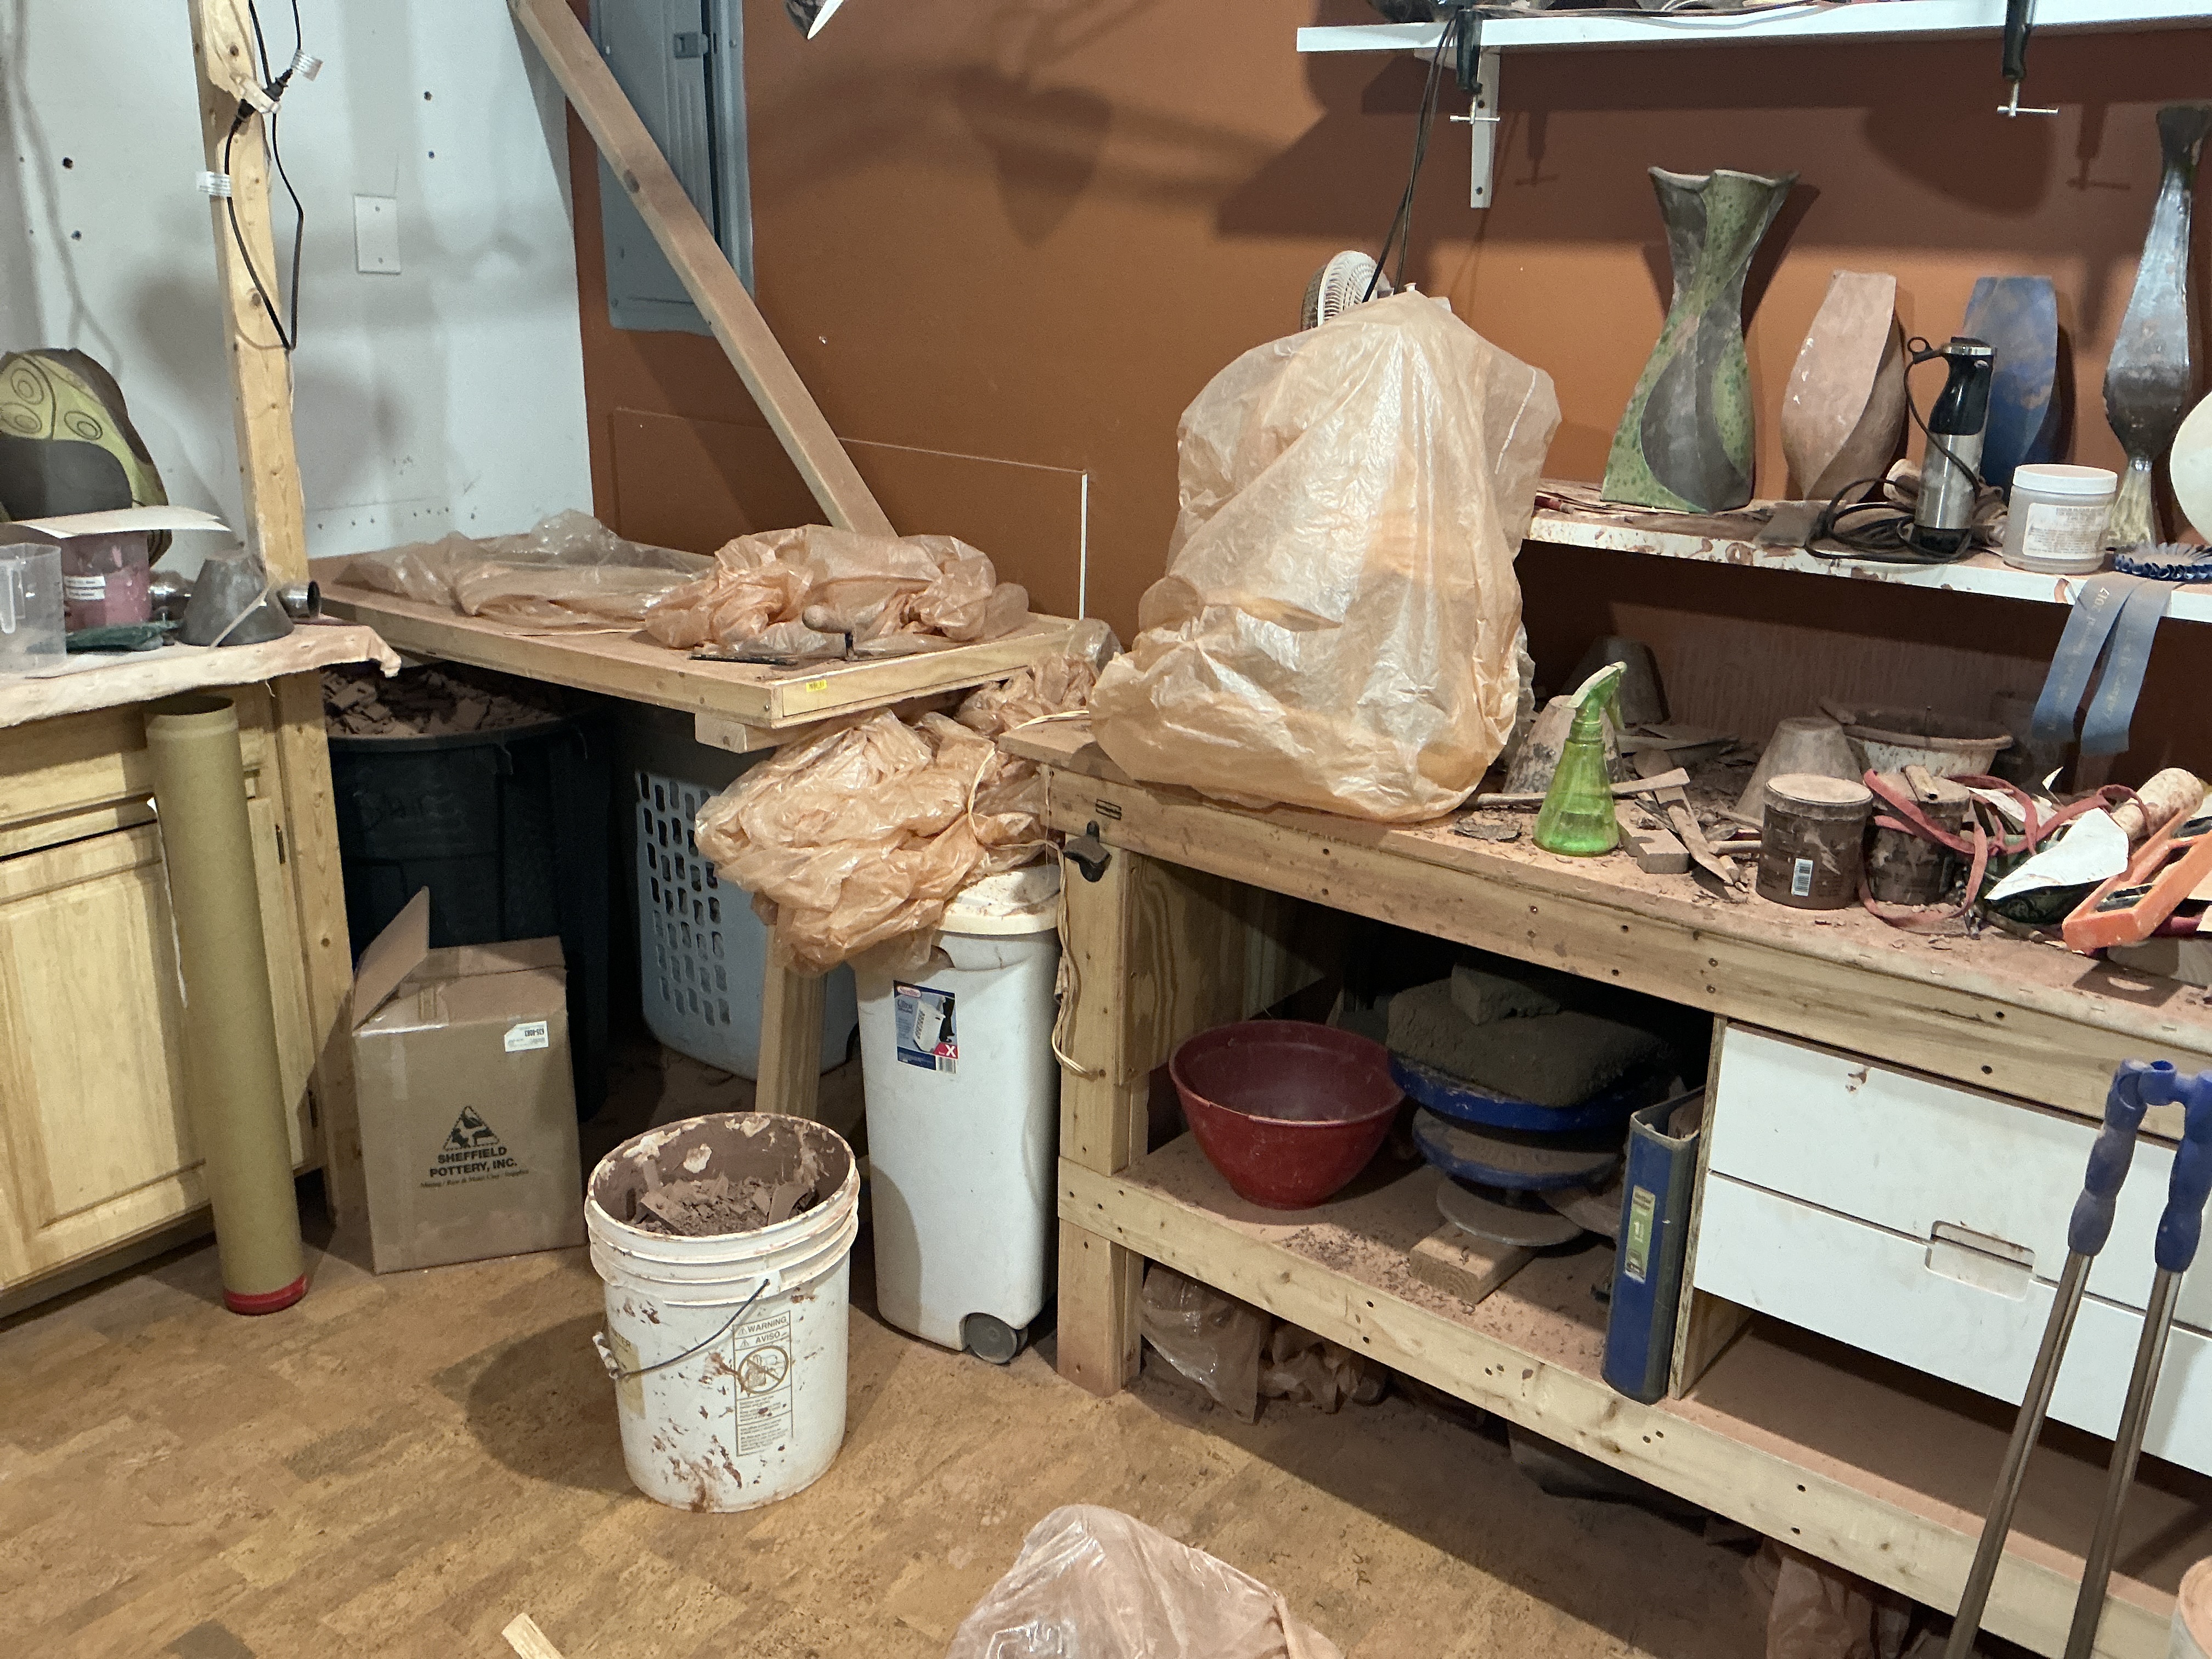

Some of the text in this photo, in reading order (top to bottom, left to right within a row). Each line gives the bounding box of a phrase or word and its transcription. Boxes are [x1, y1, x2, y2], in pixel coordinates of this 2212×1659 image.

[438, 1146, 507, 1164] SHEFFIELD
[430, 1158, 518, 1178] POTTERY, INC.
[747, 1316, 787, 1333] WARNING
[755, 1330, 780, 1344] AVISO
